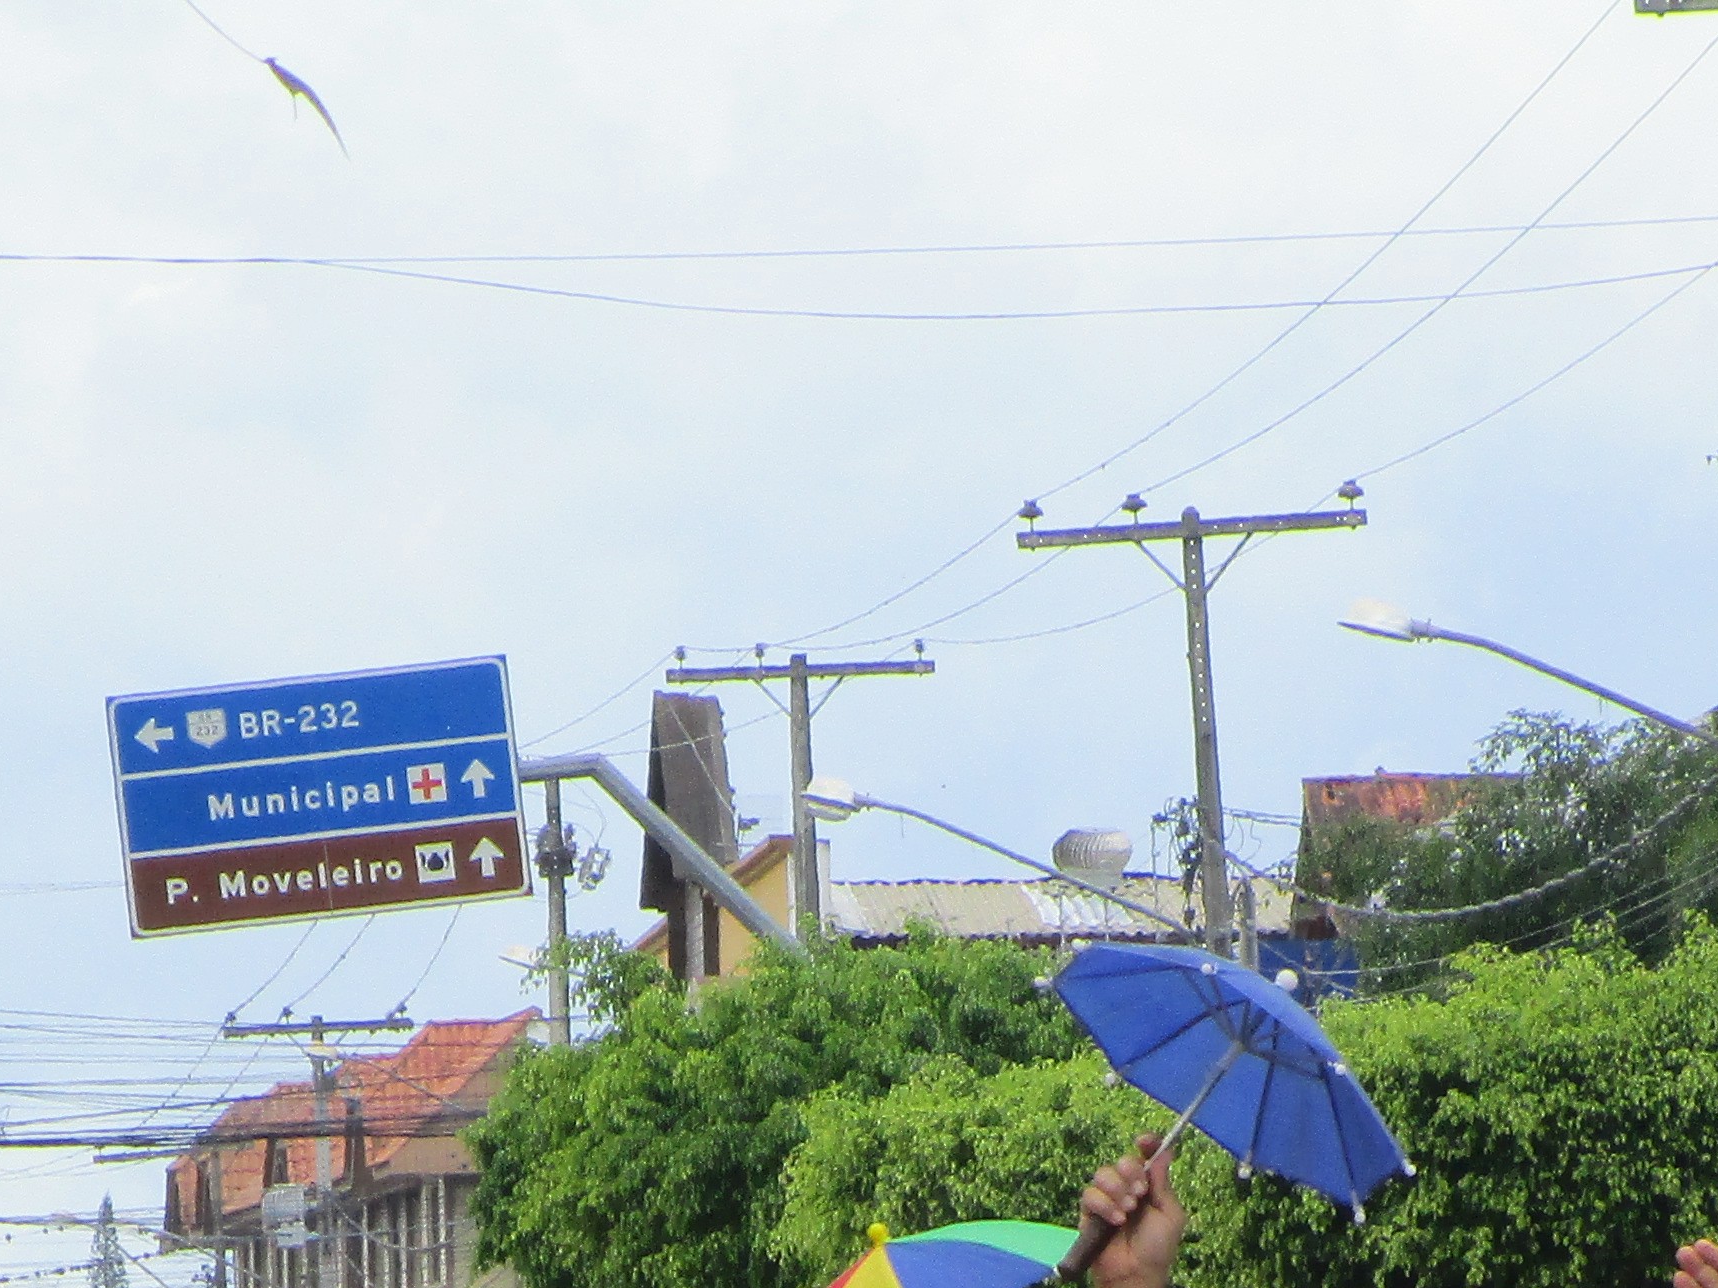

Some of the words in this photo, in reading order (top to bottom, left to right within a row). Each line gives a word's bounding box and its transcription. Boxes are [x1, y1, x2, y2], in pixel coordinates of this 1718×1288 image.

[238, 700, 361, 740] BR-232
[207, 775, 395, 822] Municipal
[164, 876, 200, 906] P.
[218, 857, 404, 899] Moveleiro
